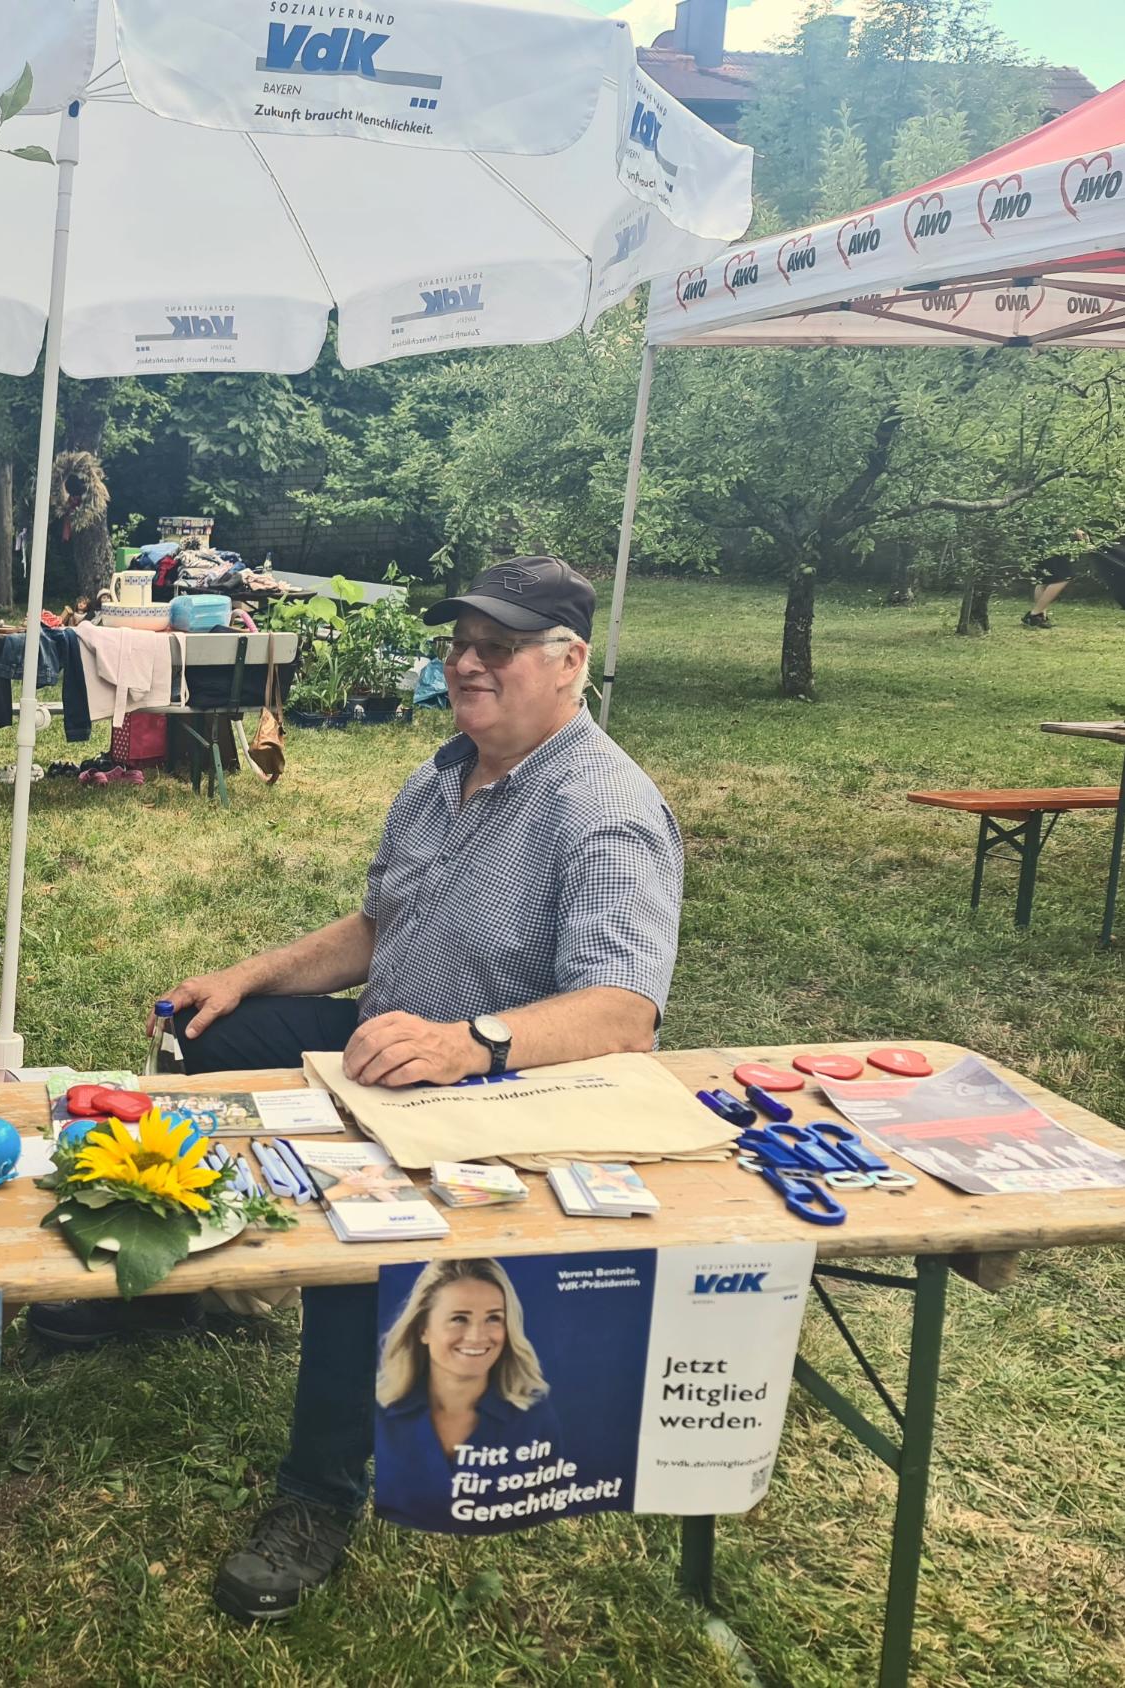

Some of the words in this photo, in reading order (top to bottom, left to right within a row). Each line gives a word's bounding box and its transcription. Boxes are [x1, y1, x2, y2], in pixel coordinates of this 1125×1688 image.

[269, 1, 395, 26] SOZIALVERBAND
[266, 22, 390, 77] VdK
[263, 82, 302, 95] BAYERN
[254, 104, 301, 122] Zukunft
[305, 108, 353, 121] braucht
[356, 111, 433, 134] Menschlichkeit.
[1073, 170, 1122, 204] AWO
[988, 192, 1032, 222] AWO
[914, 210, 952, 238] AWO
[848, 228, 881, 256] AWO
[787, 247, 816, 272] AWO
[732, 264, 758, 288] AWO
[683, 279, 707, 301] AWO
[557, 1278, 641, 1292] VdK-Präsidentin
[558, 1269, 594, 1280] Verena
[595, 1267, 636, 1277] Bentele
[694, 1272, 769, 1294] VdK
[662, 1356, 728, 1379] Jetzt
[663, 1382, 767, 1407] Mitglied
[659, 1411, 762, 1429] werden.
[454, 1444, 509, 1466] Tritt
[515, 1439, 551, 1462] ein
[451, 1471, 492, 1498] für
[497, 1458, 577, 1492] soziale
[451, 1477, 623, 1522] Gerechtigkeit!
